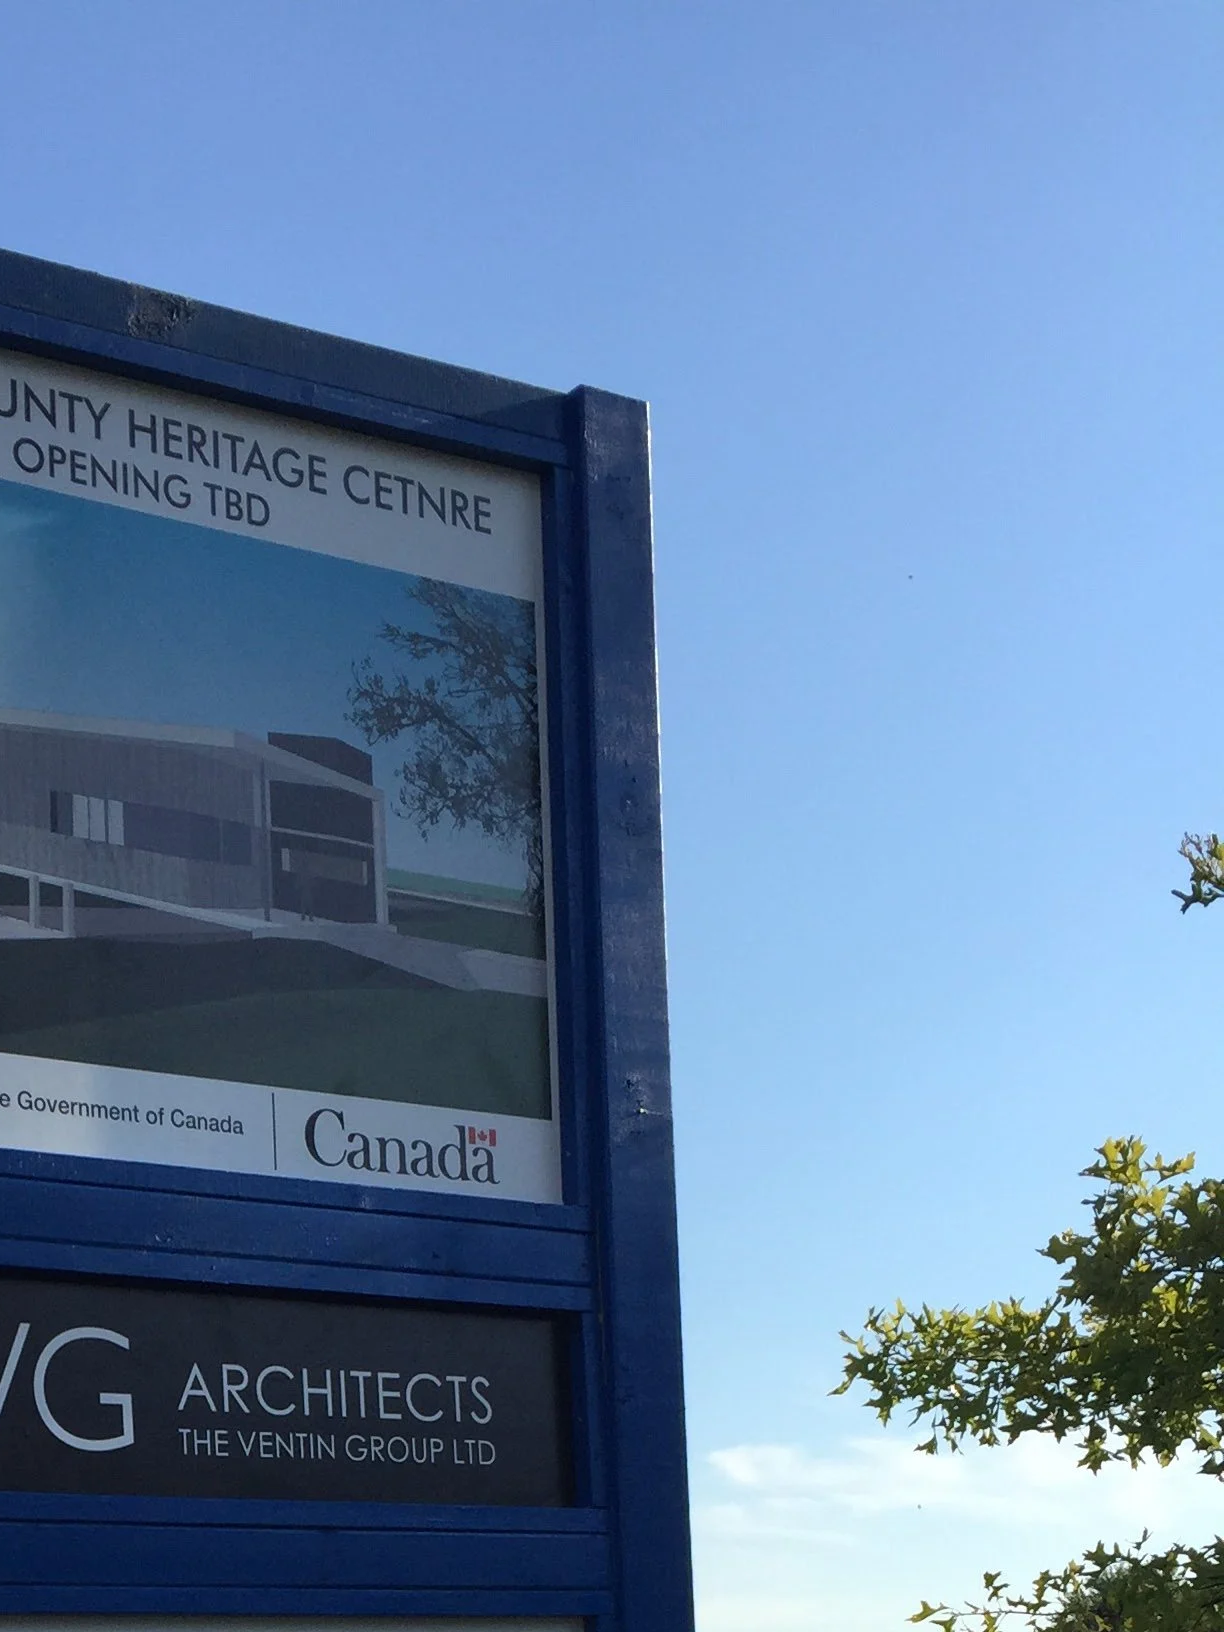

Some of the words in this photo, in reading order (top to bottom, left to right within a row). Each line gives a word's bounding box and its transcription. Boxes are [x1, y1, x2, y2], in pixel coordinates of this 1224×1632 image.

[12, 436, 193, 510] OPENING
[202, 481, 271, 528] TBD
[128, 408, 327, 496] HERITAGE
[342, 464, 493, 536] CETNRE
[16, 1090, 140, 1123] Government
[146, 1105, 166, 1126] of
[170, 1107, 245, 1137] Canada
[303, 1107, 500, 1186] Canada
[178, 1362, 494, 1426] ARCHITECTS
[178, 1427, 231, 1457] THE
[238, 1430, 336, 1461] VENTIN
[344, 1434, 445, 1465] GROUP
[452, 1439, 496, 1466] LTD
